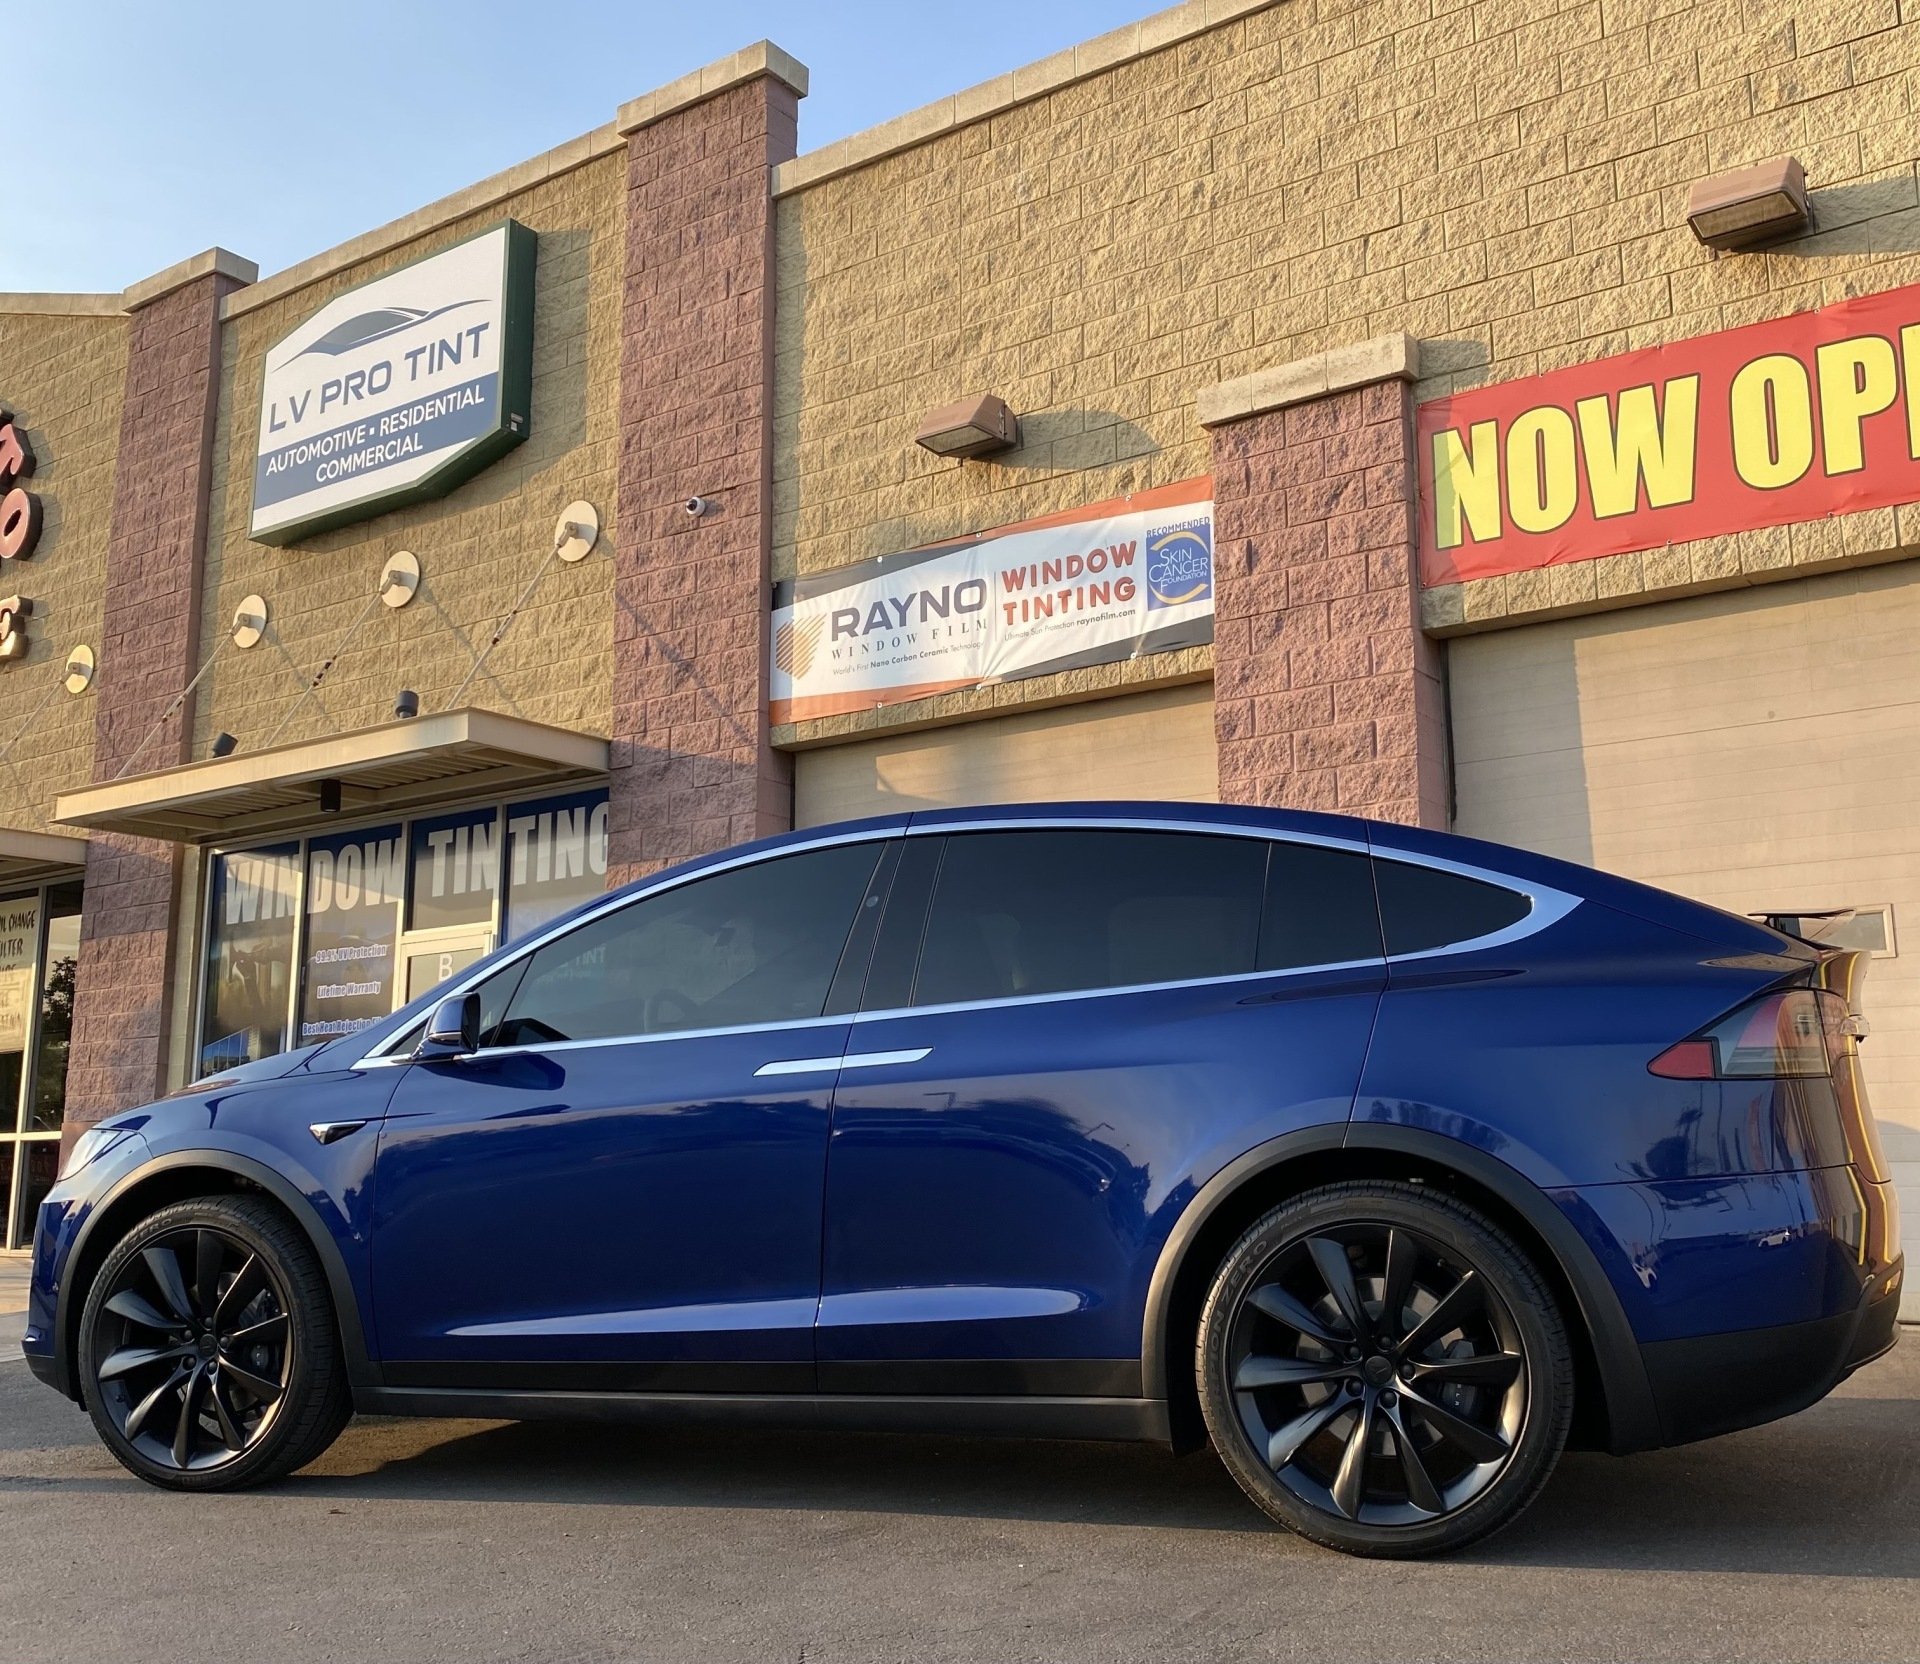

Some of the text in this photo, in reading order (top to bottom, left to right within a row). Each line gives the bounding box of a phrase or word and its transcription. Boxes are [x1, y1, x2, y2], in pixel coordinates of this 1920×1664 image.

[269, 321, 490, 434] LV PRO TINT
[266, 384, 485, 476] AUTOMOTIVE RESIDENTIAL
[1431, 322, 1920, 552] NOW OP
[315, 433, 424, 483] COMMERCIAL
[1146, 516, 1211, 538] RECOMMENDED
[1001, 540, 1137, 593] WINDOW
[831, 578, 988, 642] RAYNO
[1002, 576, 1137, 626] TINTING
[831, 618, 988, 660] WINDOW FILM
[1030, 627, 1043, 636] Sun
[1076, 609, 1137, 627] raynofilm.com
[870, 659, 890, 669] Nano
[891, 653, 918, 665] Carbon
[919, 647, 949, 659] Ceramic
[349, 944, 387, 960] Protection
[438, 952, 453, 982] B
[317, 981, 381, 999] Lifetime Warranty
[303, 1022, 320, 1036] Best
[319, 1020, 337, 1034] Heat
